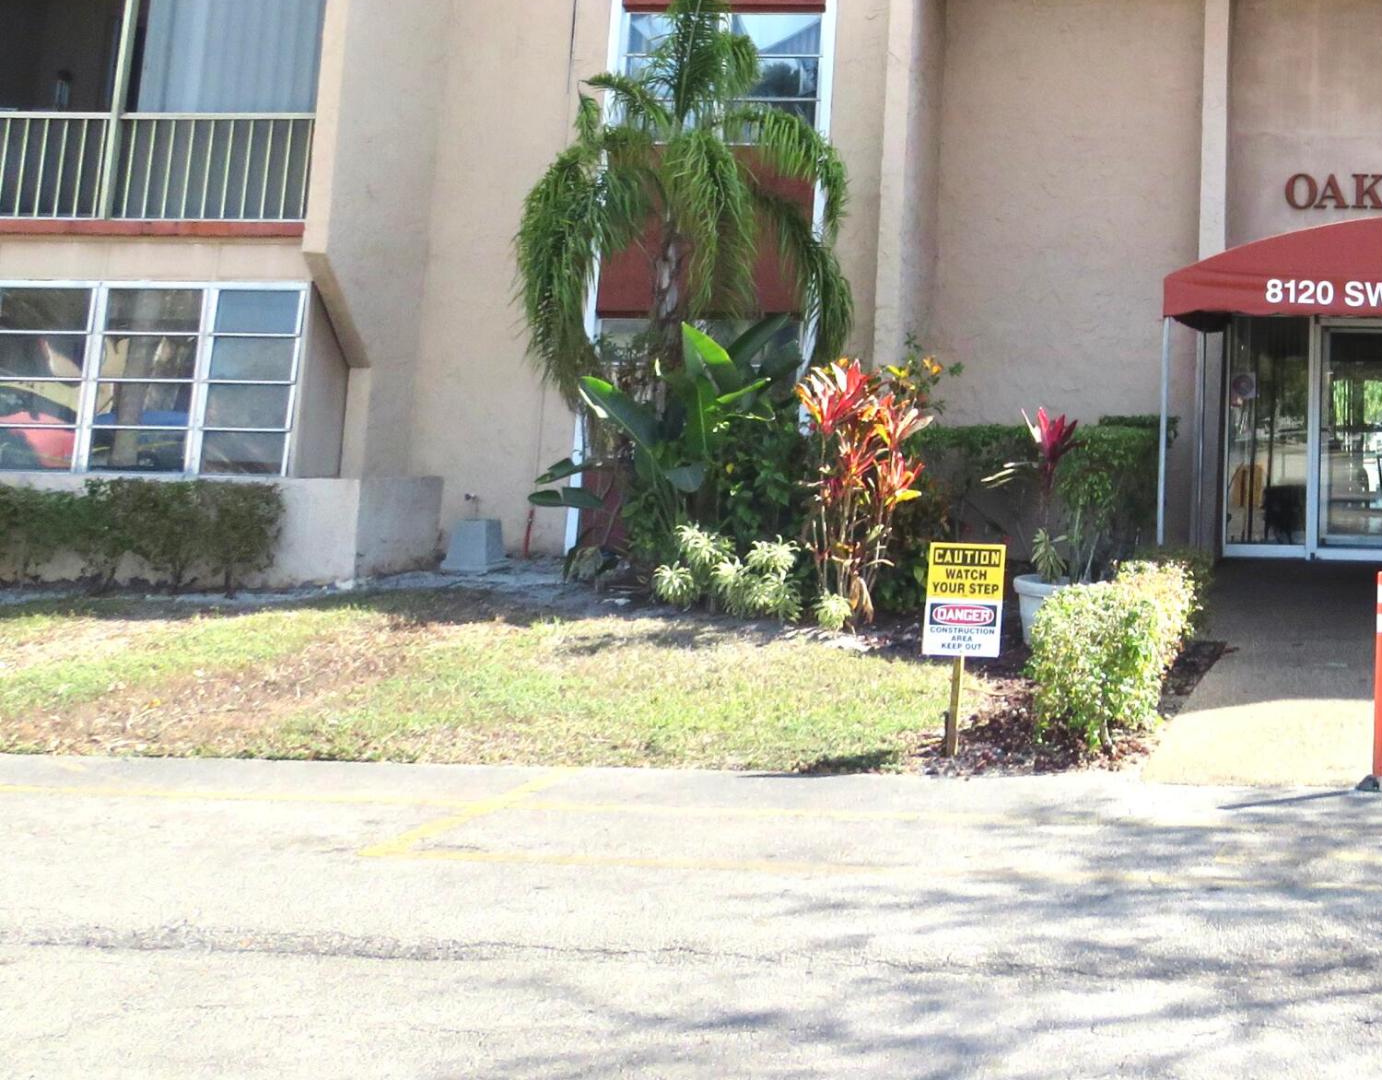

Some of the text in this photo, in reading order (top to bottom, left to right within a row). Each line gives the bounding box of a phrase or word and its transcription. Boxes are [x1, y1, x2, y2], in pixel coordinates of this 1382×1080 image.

[1265, 278, 1334, 305] 8120
[935, 549, 1000, 565] CAUTION
[945, 568, 987, 580] WATCH
[932, 582, 999, 595] YOUR STEP
[937, 609, 991, 621] DANGER
[930, 626, 995, 635] CONSTRUCTION
